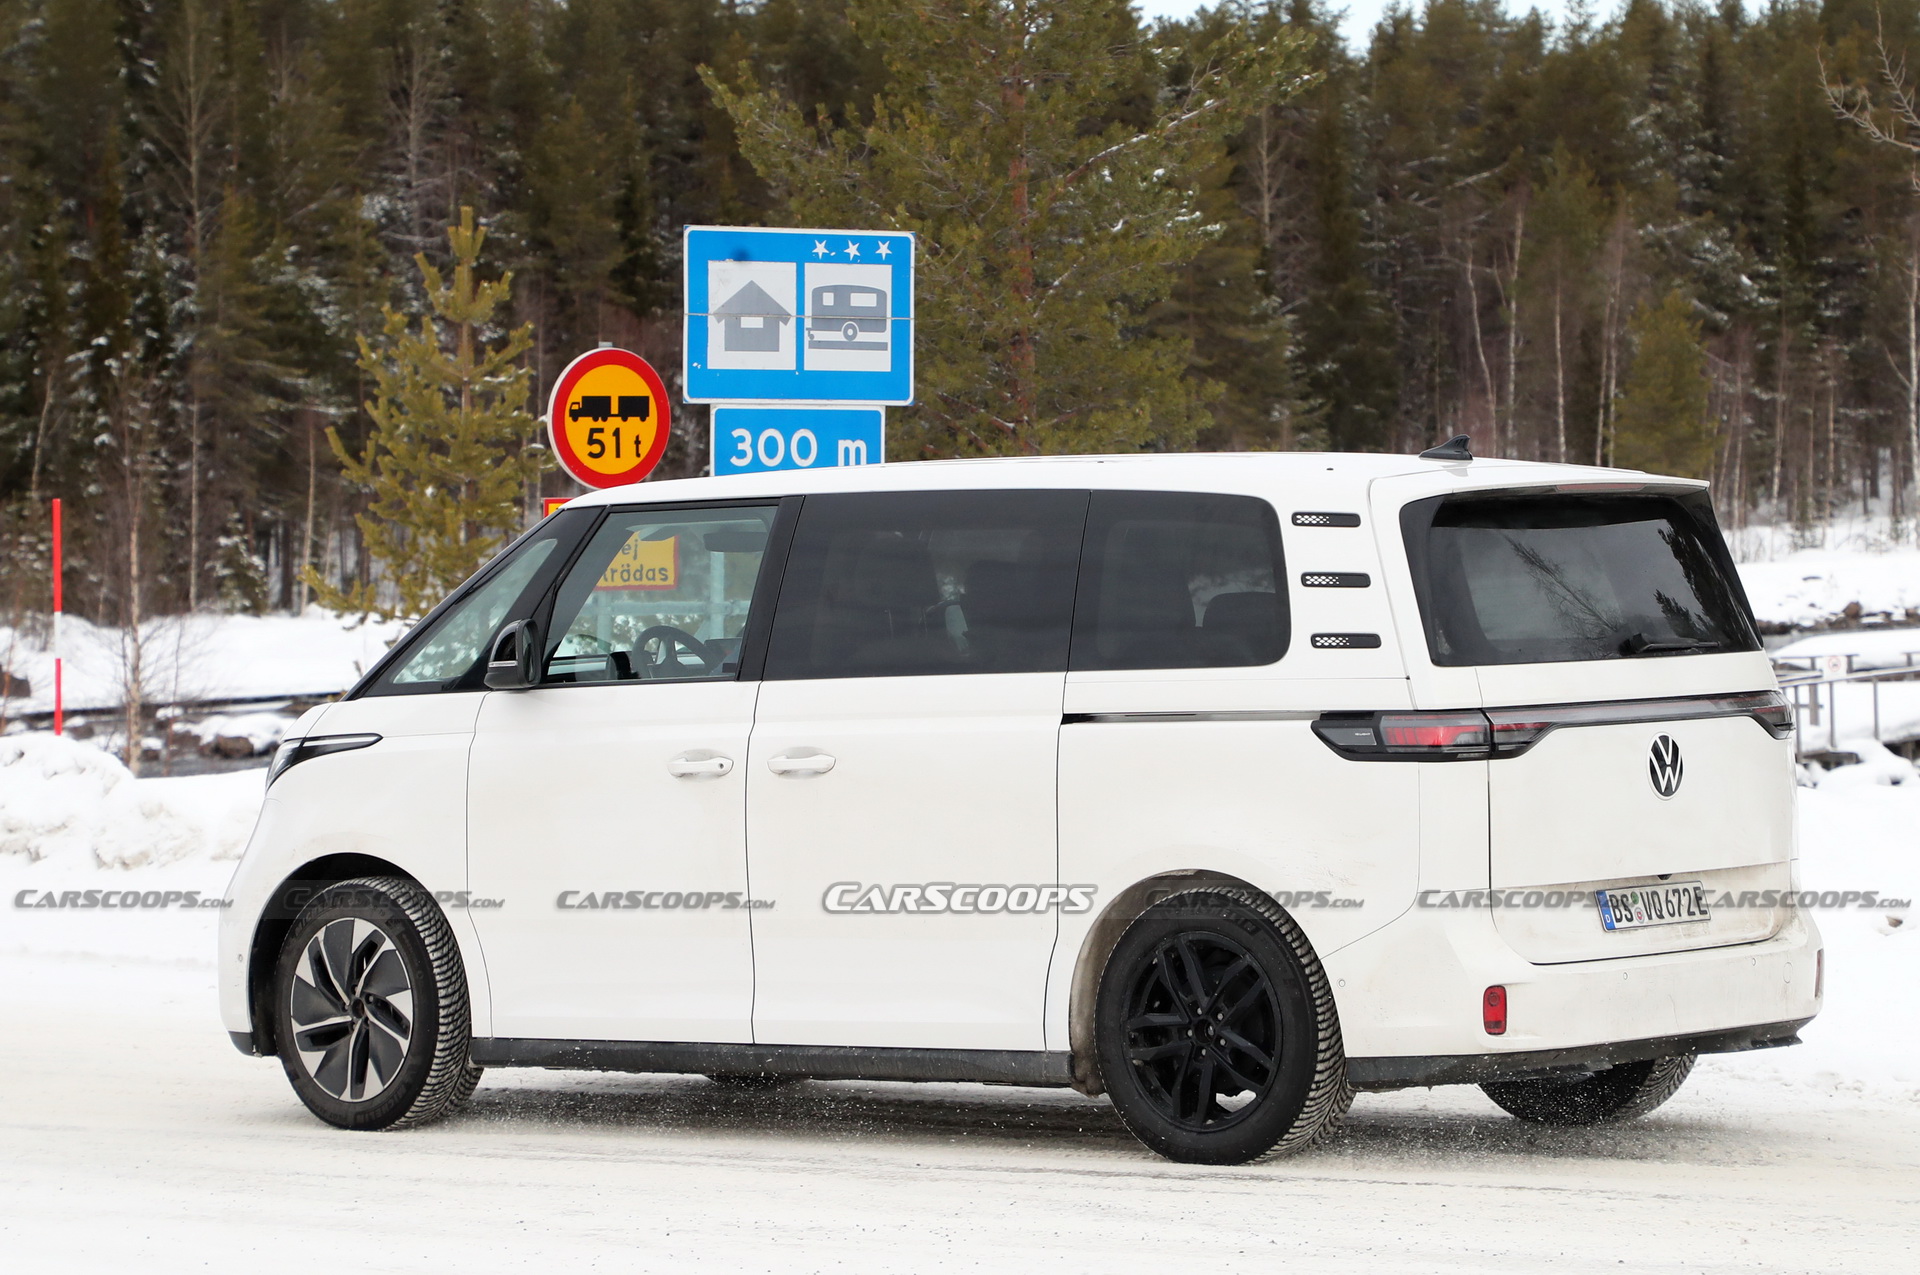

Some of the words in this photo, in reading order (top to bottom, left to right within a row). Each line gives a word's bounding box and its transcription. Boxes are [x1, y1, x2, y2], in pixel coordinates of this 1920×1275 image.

[587, 427, 621, 459] 51
[634, 434, 641, 458] t
[730, 428, 818, 467] 300
[838, 439, 867, 467] m
[621, 538, 639, 560] ej
[1609, 893, 1634, 923] BS
[1640, 890, 1665, 920] VQ
[1665, 886, 1708, 918] 672E
